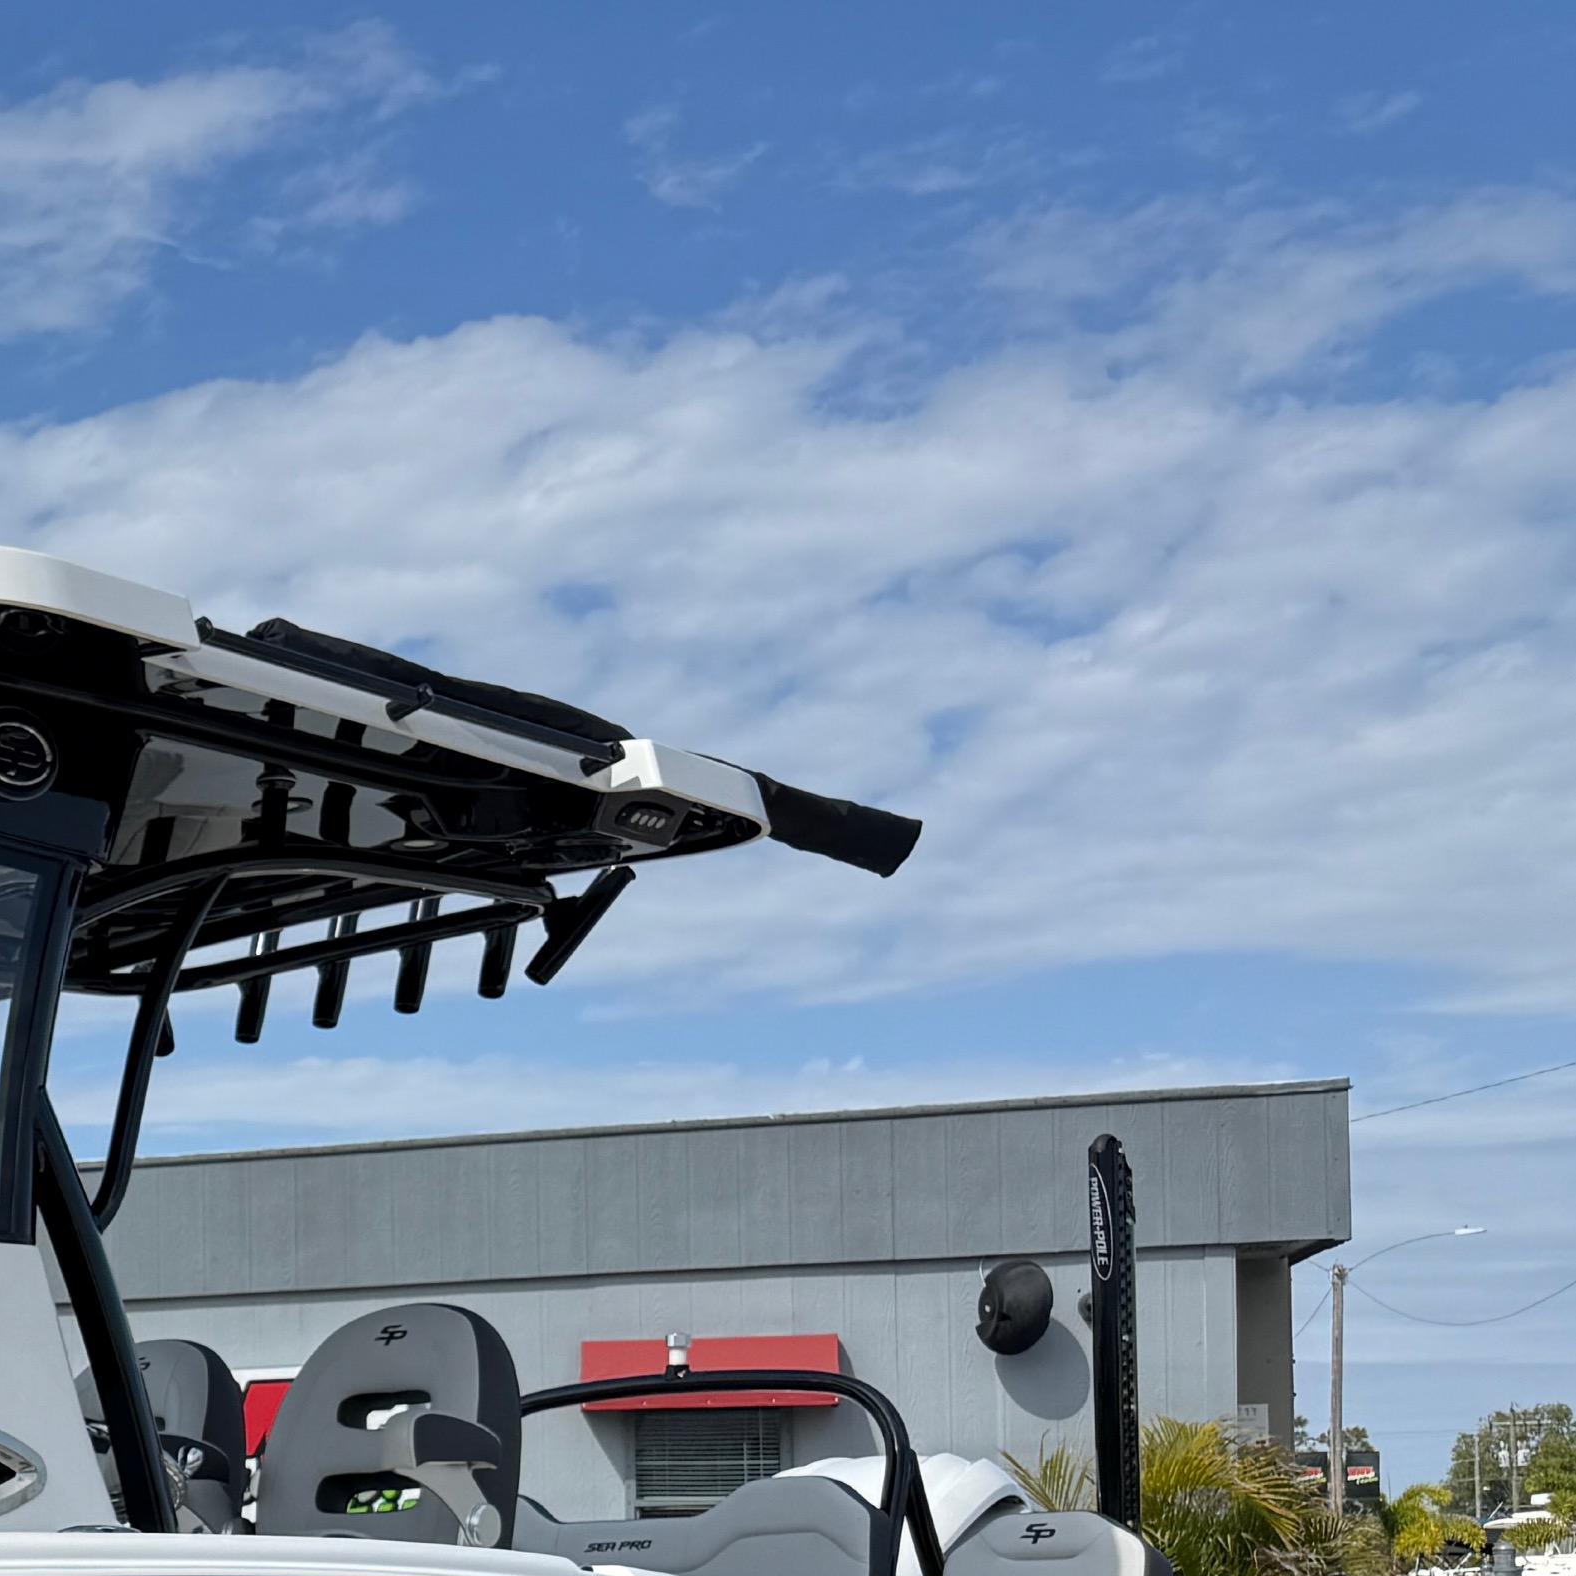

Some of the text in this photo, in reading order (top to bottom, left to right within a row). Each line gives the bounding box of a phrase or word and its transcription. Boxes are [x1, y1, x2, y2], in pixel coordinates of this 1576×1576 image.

[1089, 1176, 1109, 1267] POWER-POLE
[583, 1539, 653, 1553] SEA PRO
